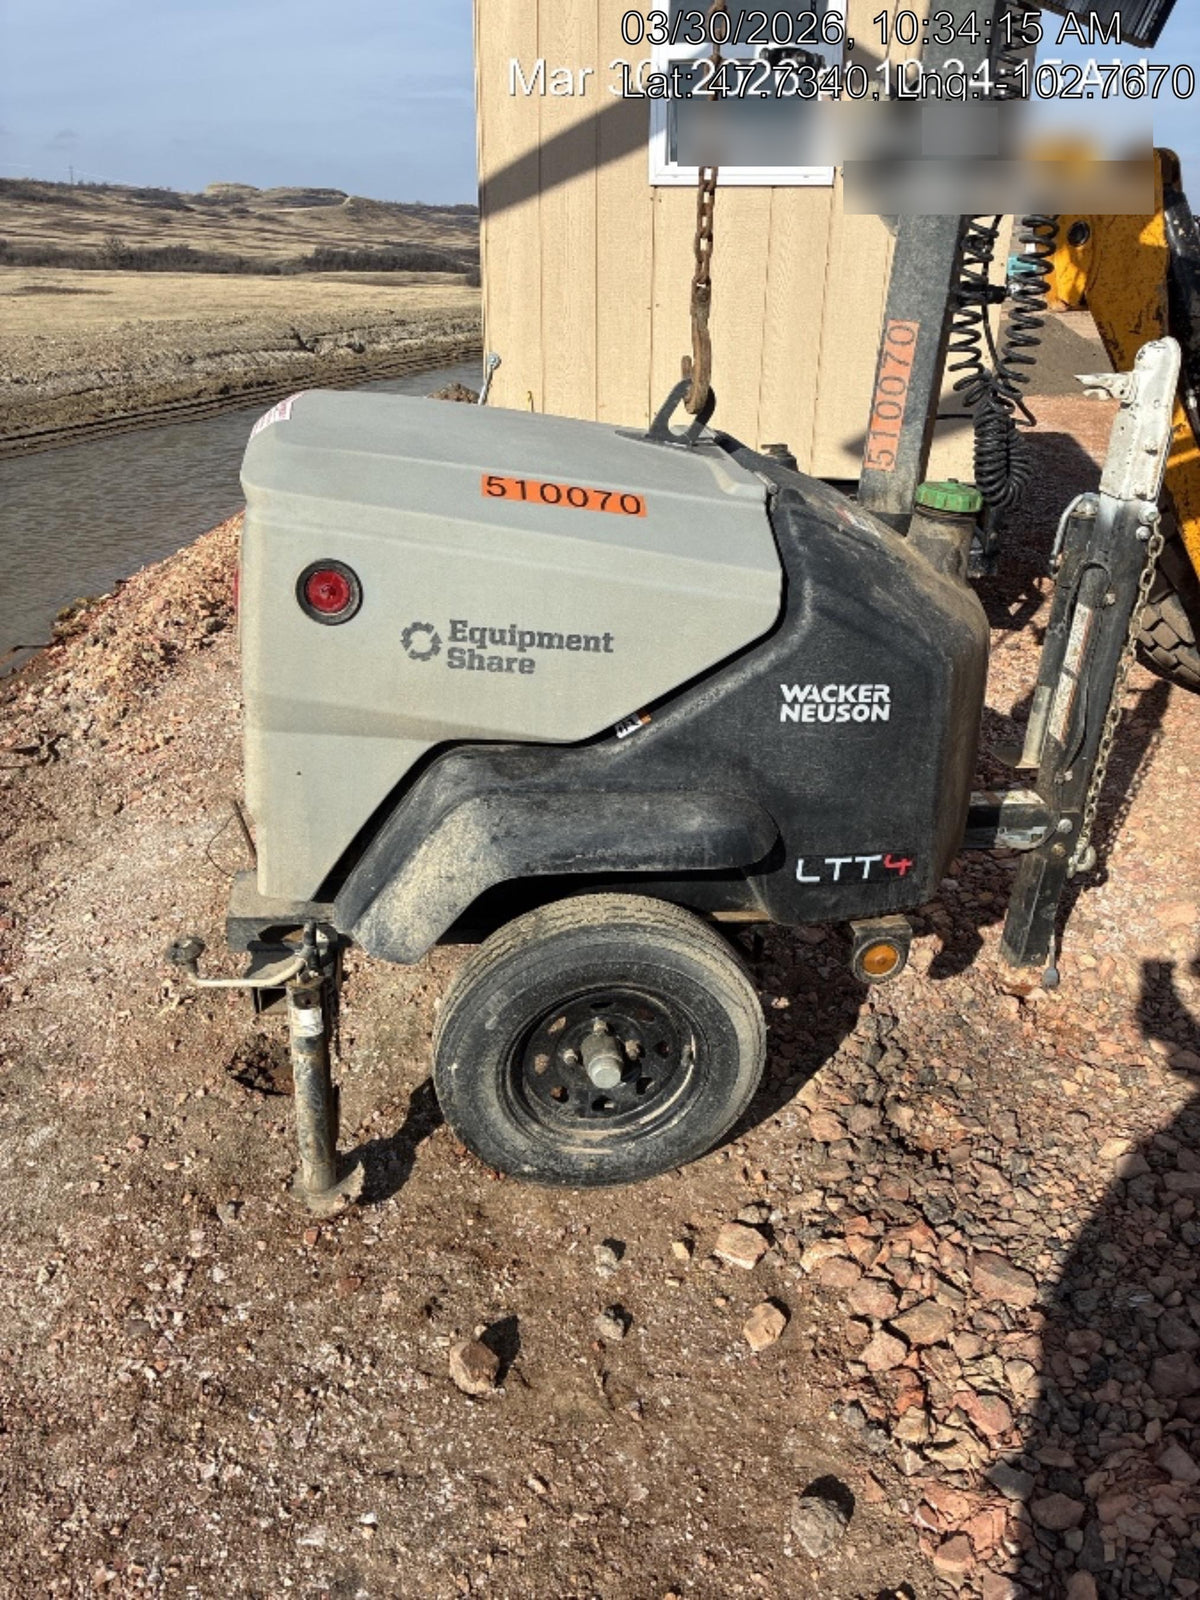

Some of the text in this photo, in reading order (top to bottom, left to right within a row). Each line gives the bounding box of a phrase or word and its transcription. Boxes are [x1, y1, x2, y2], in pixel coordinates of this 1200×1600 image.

[867, 325, 915, 467] 510070
[486, 475, 641, 515] 510070
[448, 619, 614, 653] Equipment
[447, 647, 536, 674] Share
[780, 683, 891, 703] WACKER
[780, 703, 891, 722] NEUSON
[796, 854, 913, 882] LTT4
